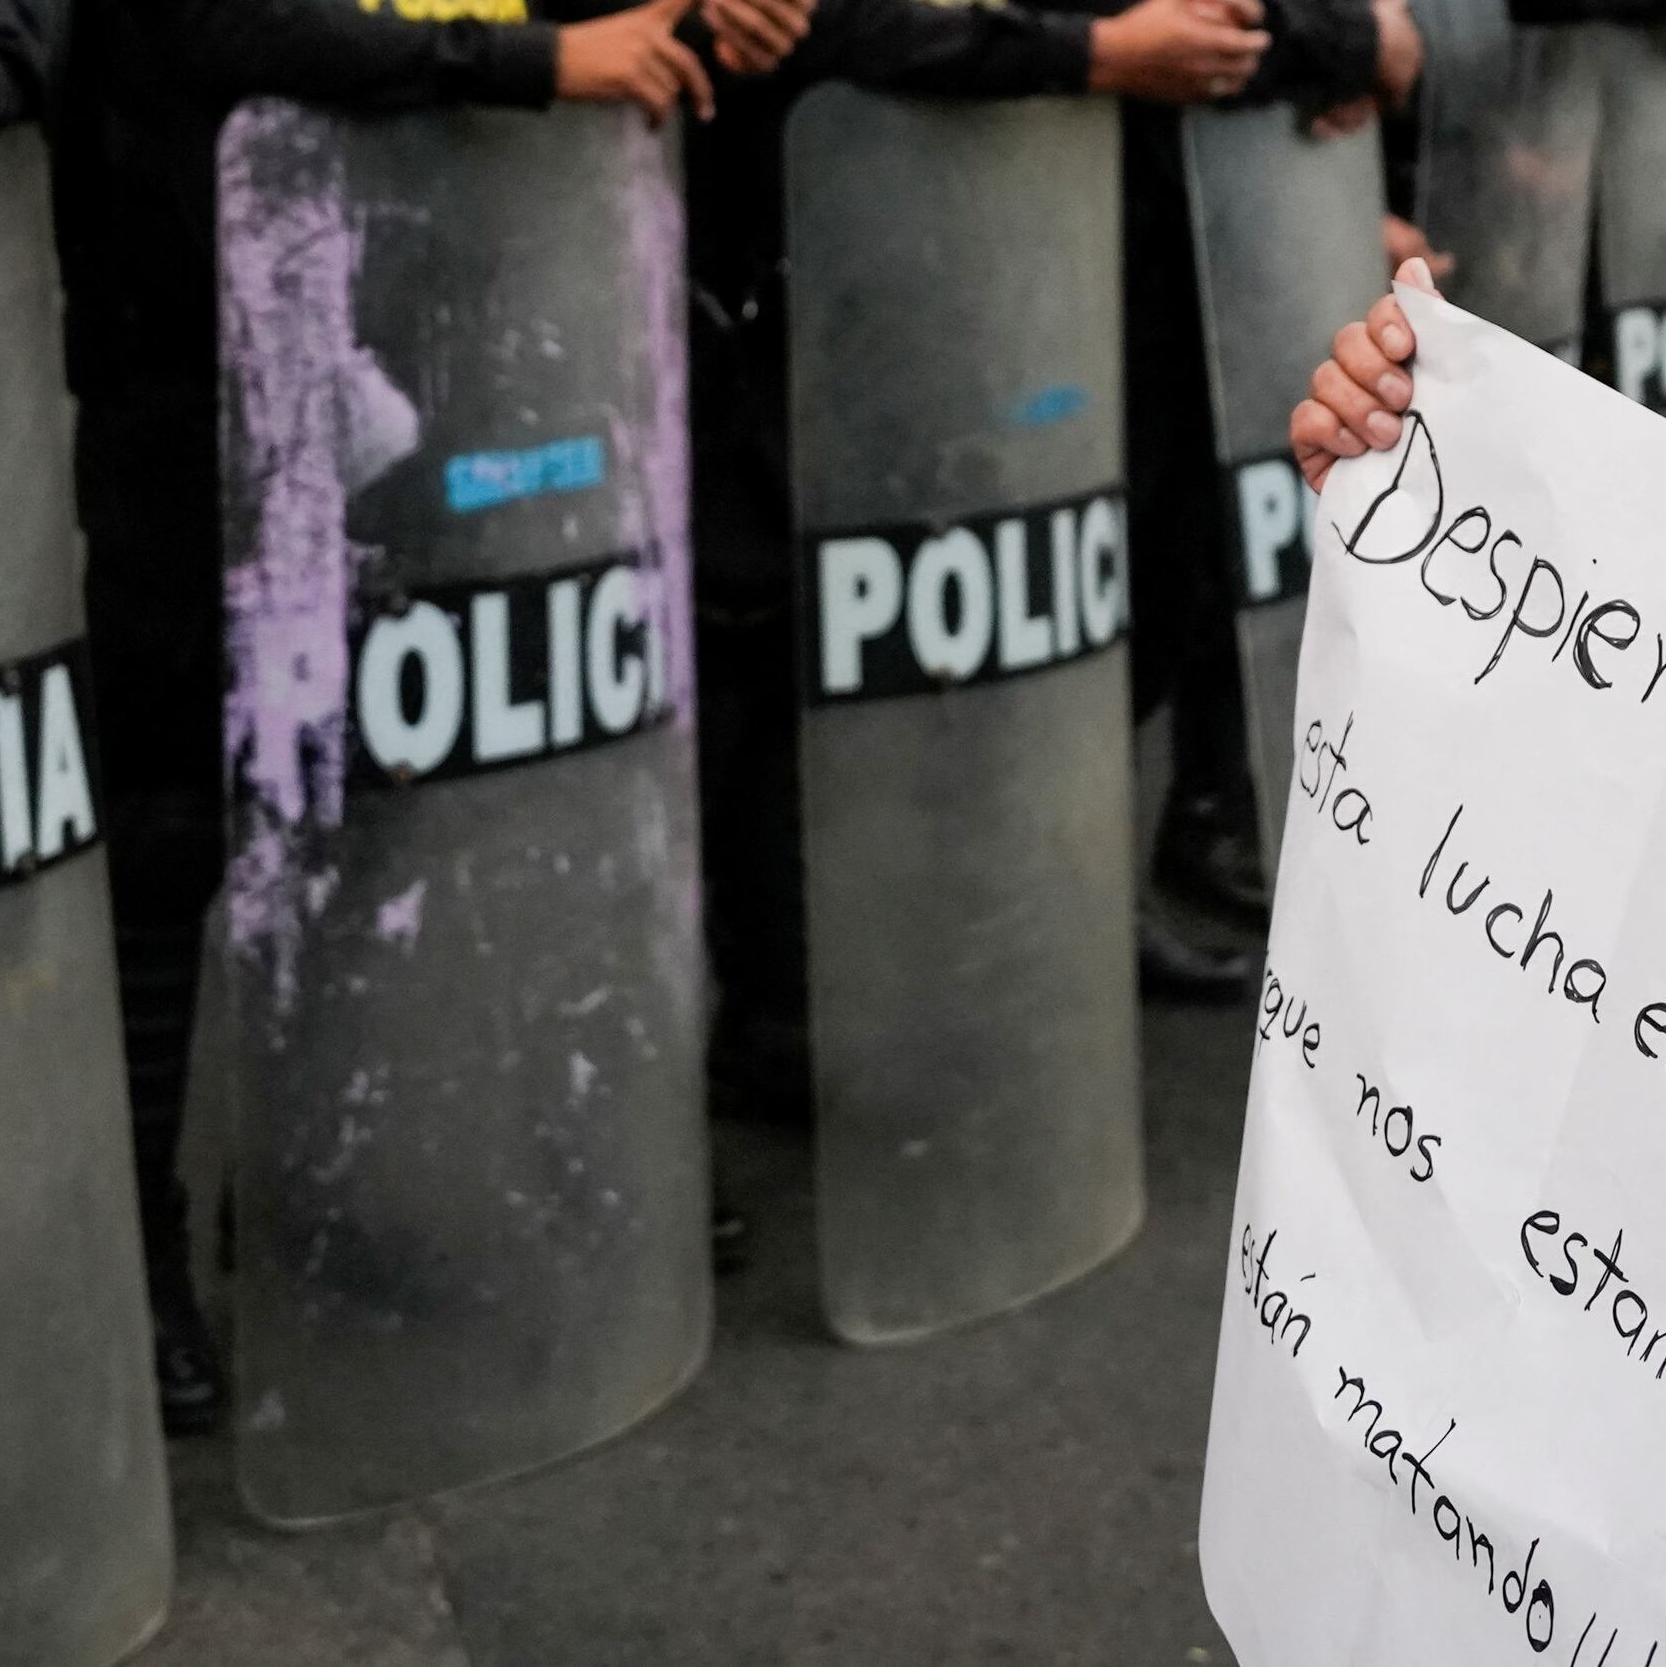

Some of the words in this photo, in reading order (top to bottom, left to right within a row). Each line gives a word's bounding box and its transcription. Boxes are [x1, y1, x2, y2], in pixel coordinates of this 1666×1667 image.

[1238, 458, 1318, 601] P
[1300, 710, 1374, 846] esta
[1419, 803, 1606, 1025] lucha
[1257, 969, 1321, 1070] que
[1355, 1072, 1443, 1183] nos
